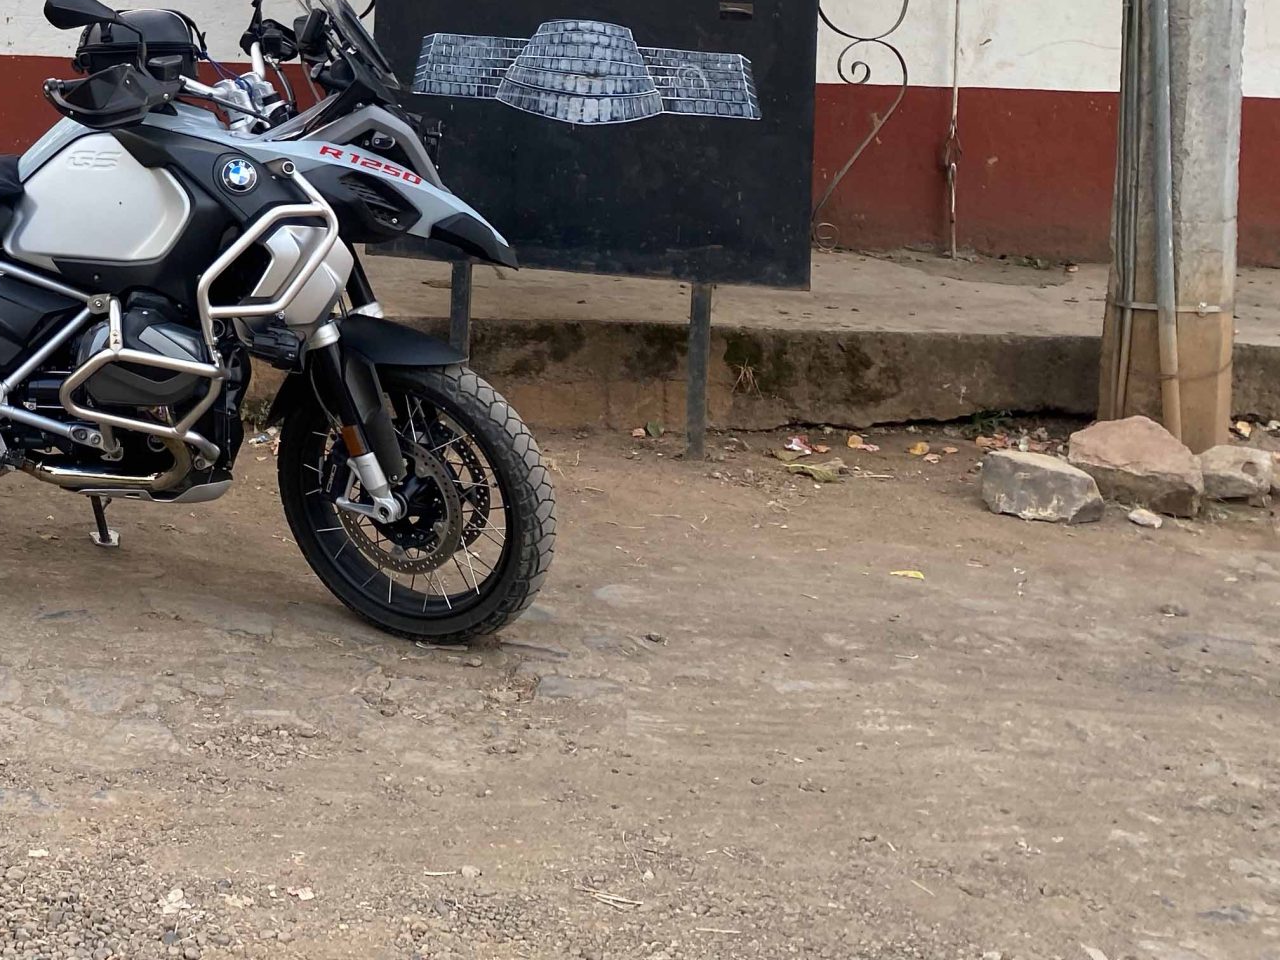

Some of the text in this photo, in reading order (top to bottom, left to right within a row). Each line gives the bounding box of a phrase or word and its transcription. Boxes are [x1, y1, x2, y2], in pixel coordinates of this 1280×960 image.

[67, 150, 122, 169] GS
[320, 145, 422, 184] R 1250
